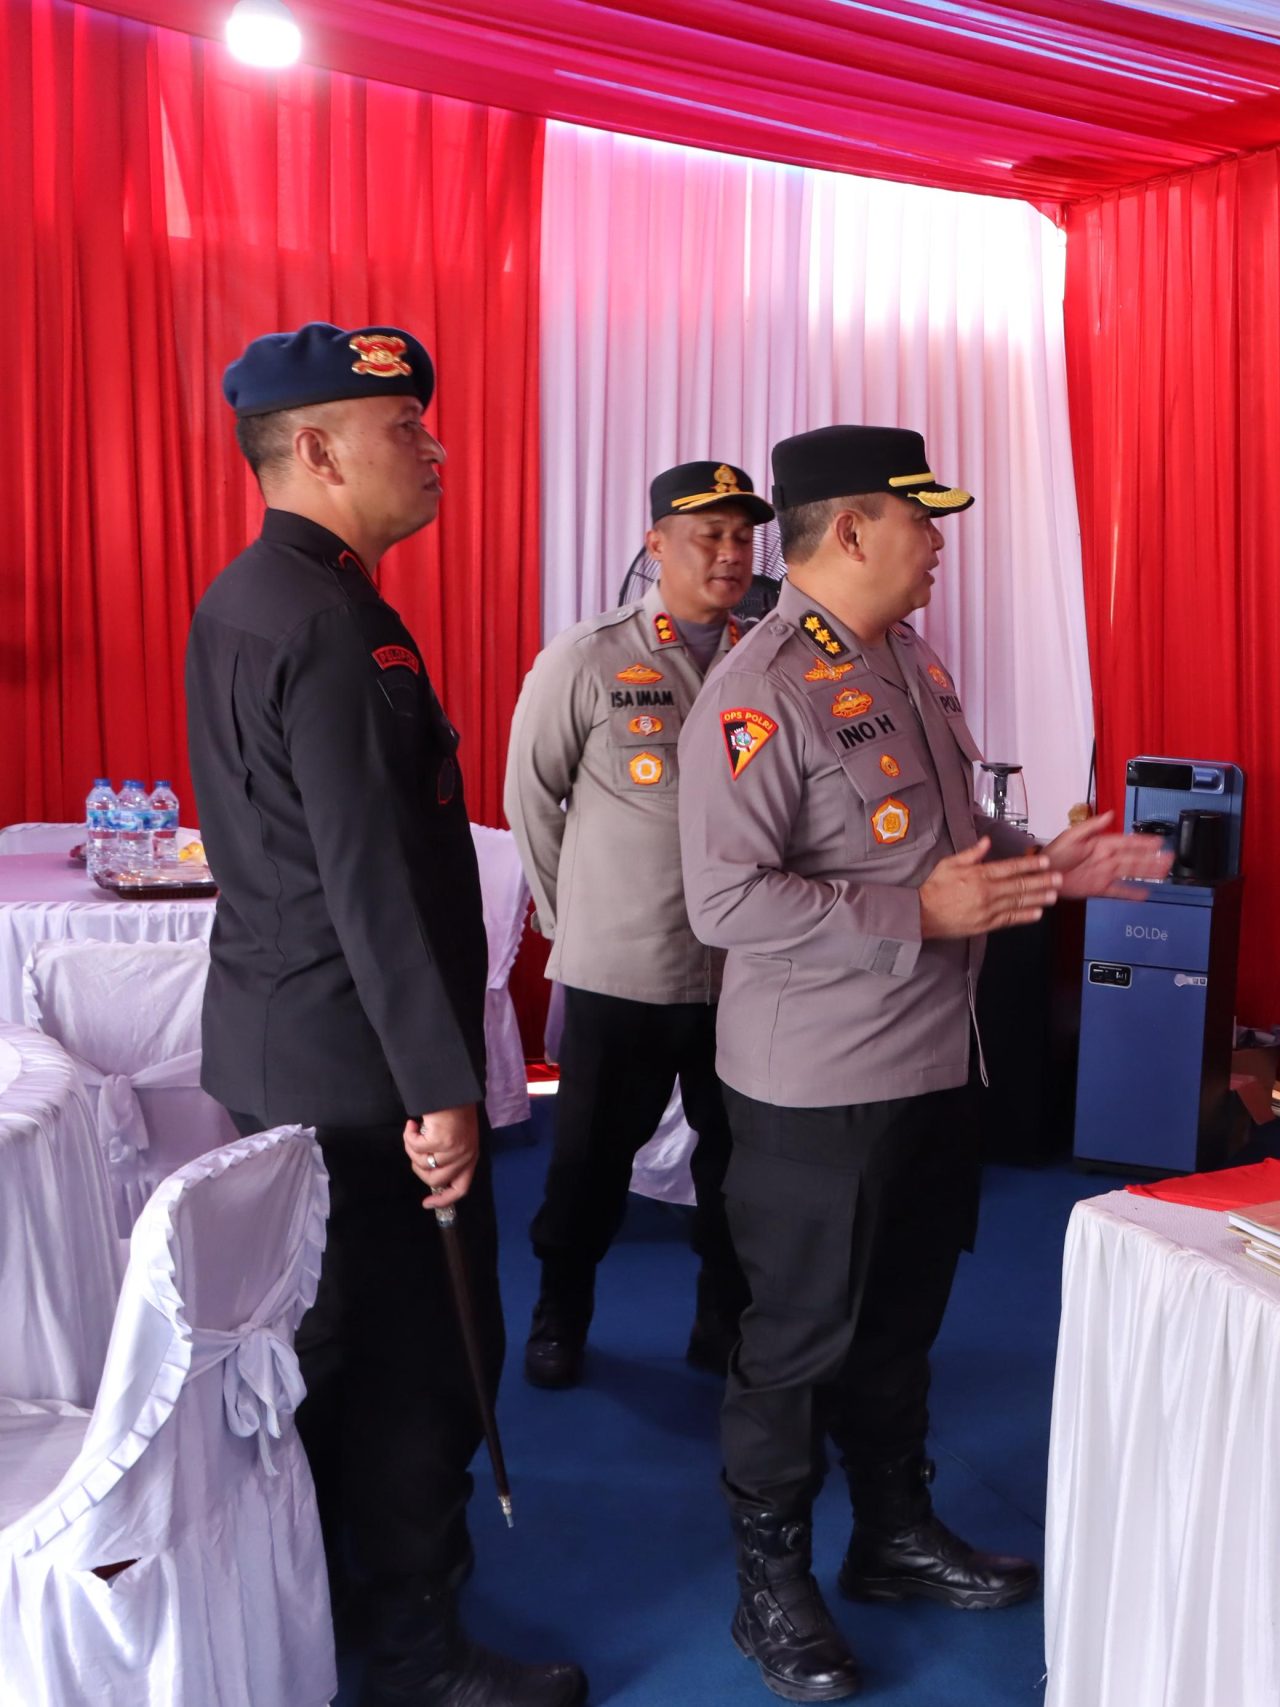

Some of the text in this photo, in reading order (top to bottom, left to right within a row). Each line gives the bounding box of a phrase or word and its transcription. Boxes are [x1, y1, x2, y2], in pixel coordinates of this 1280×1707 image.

[610, 690, 675, 708] ISA IMAM
[724, 711, 773, 730] OPS POLRI
[836, 713, 897, 750] INO H
